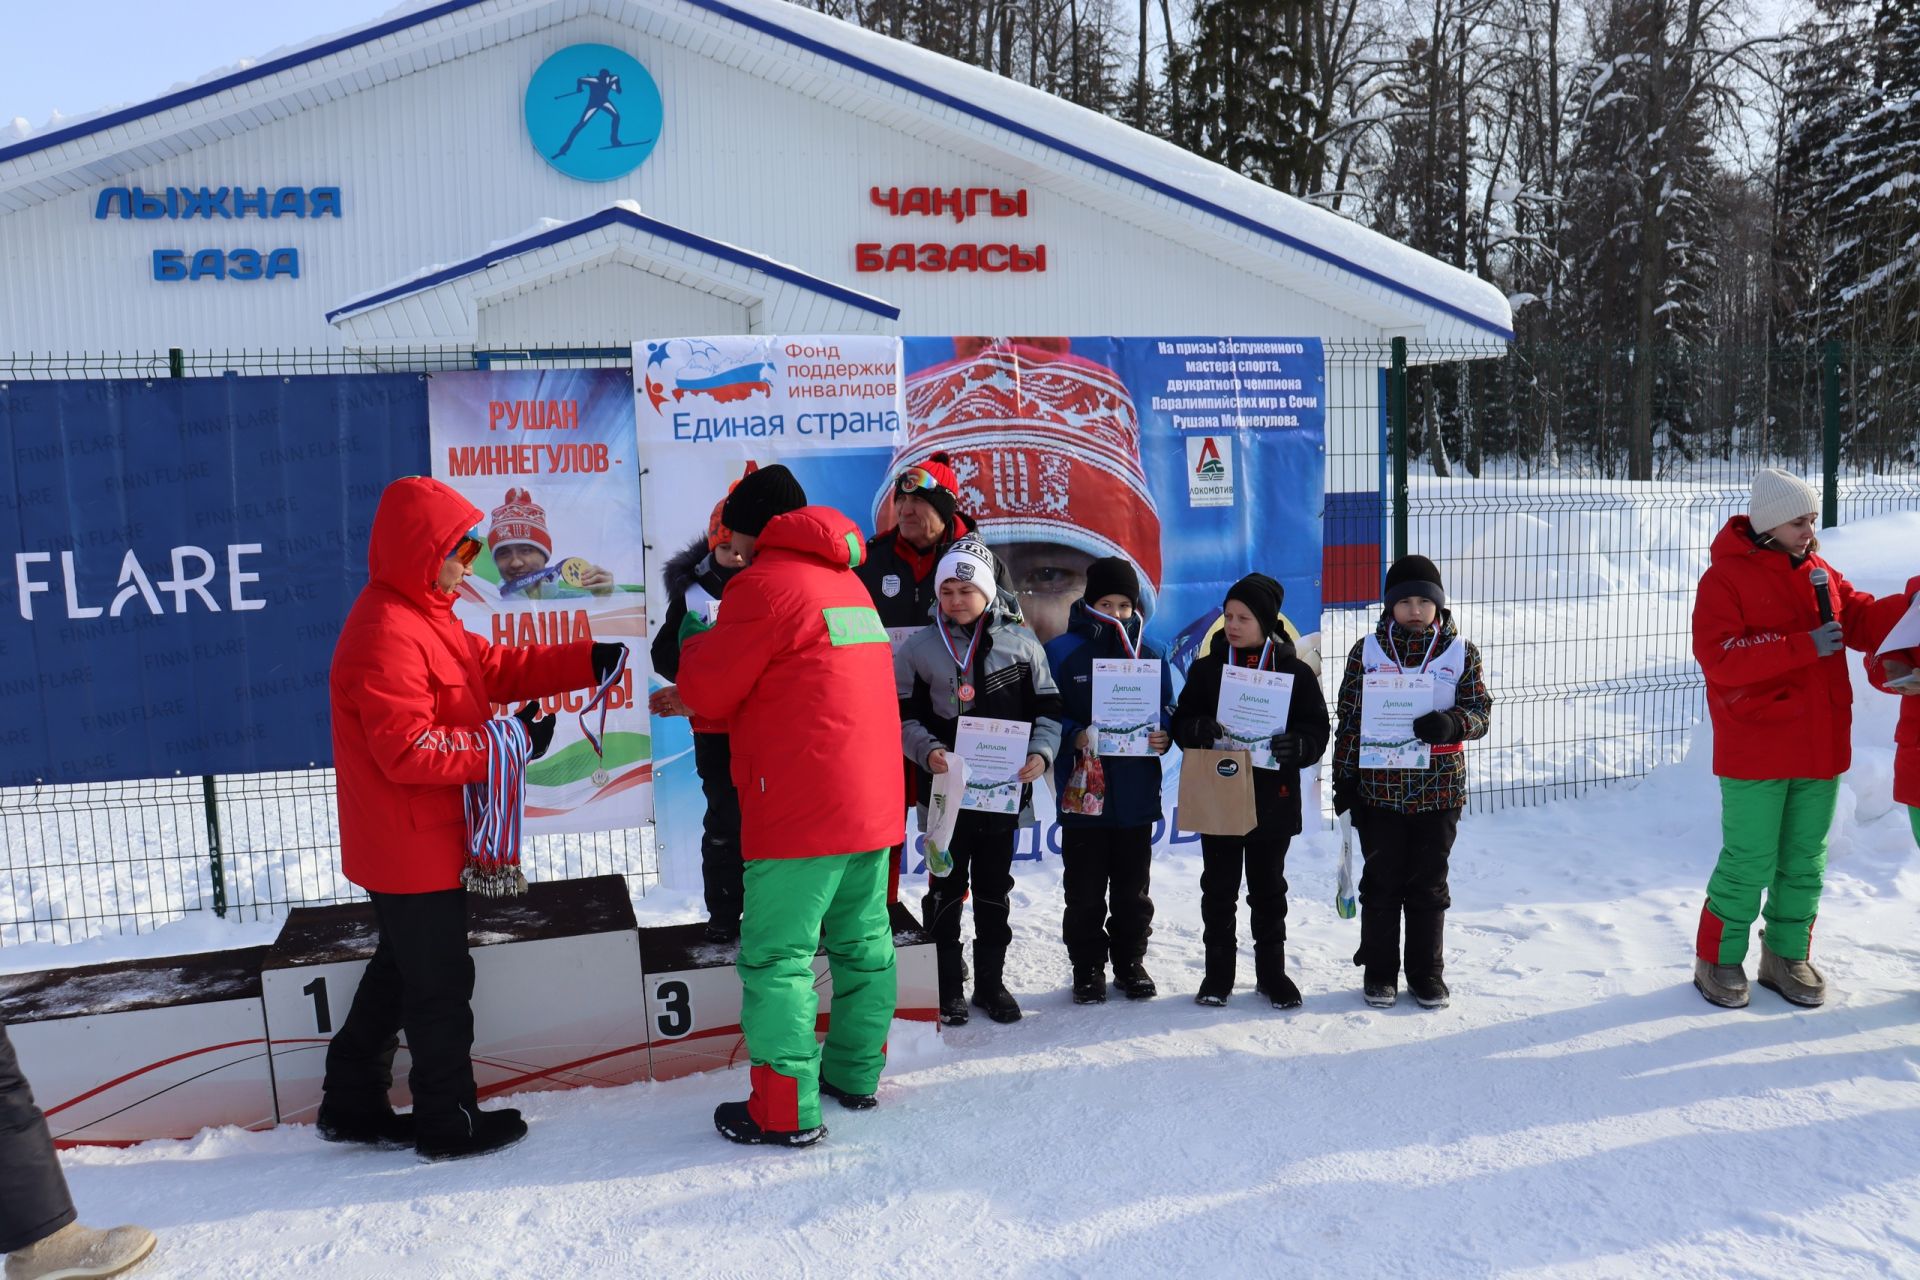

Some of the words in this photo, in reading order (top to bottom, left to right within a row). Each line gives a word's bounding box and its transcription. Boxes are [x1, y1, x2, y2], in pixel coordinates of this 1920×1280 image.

[95, 187, 342, 219] ЛЫЖНАЯ
[870, 187, 1028, 224] ЧАҢГЫ
[153, 248, 299, 281] БАЗА
[856, 243, 1046, 272] БАЗАСЫ
[785, 344, 840, 360] Фонд
[1158, 342, 1174, 354] На
[1176, 343, 1217, 355] призы
[1219, 341, 1303, 355] Заслуженного
[787, 362, 896, 382] поддержки
[1186, 360, 1235, 373] мастера
[1239, 360, 1281, 373] спорта,
[789, 383, 897, 399] инвалидов
[1167, 379, 1241, 392] двукратного
[1244, 379, 1302, 390] чемпиона
[1152, 395, 1257, 411] Паралимпийских
[1259, 397, 1277, 411] игр
[1280, 398, 1286, 409] в
[1289, 395, 1317, 409] Сочи
[489, 400, 578, 430] РУШАН
[1173, 414, 1219, 429] Рушана
[673, 412, 784, 443] Единая
[797, 410, 899, 440] страна
[449, 444, 609, 477] МИННЕГУЛОВ
[1190, 486, 1233, 495] ЛОКОМОТИВ
[15, 544, 267, 620] FLARE
[492, 610, 592, 649] НАША
[1112, 684, 1141, 693] Диплом
[1240, 693, 1270, 704] Диплом
[1383, 699, 1412, 709] Диплом
[976, 741, 1007, 751] Диплом
[303, 977, 332, 1033] 1
[656, 980, 692, 1037] 3
